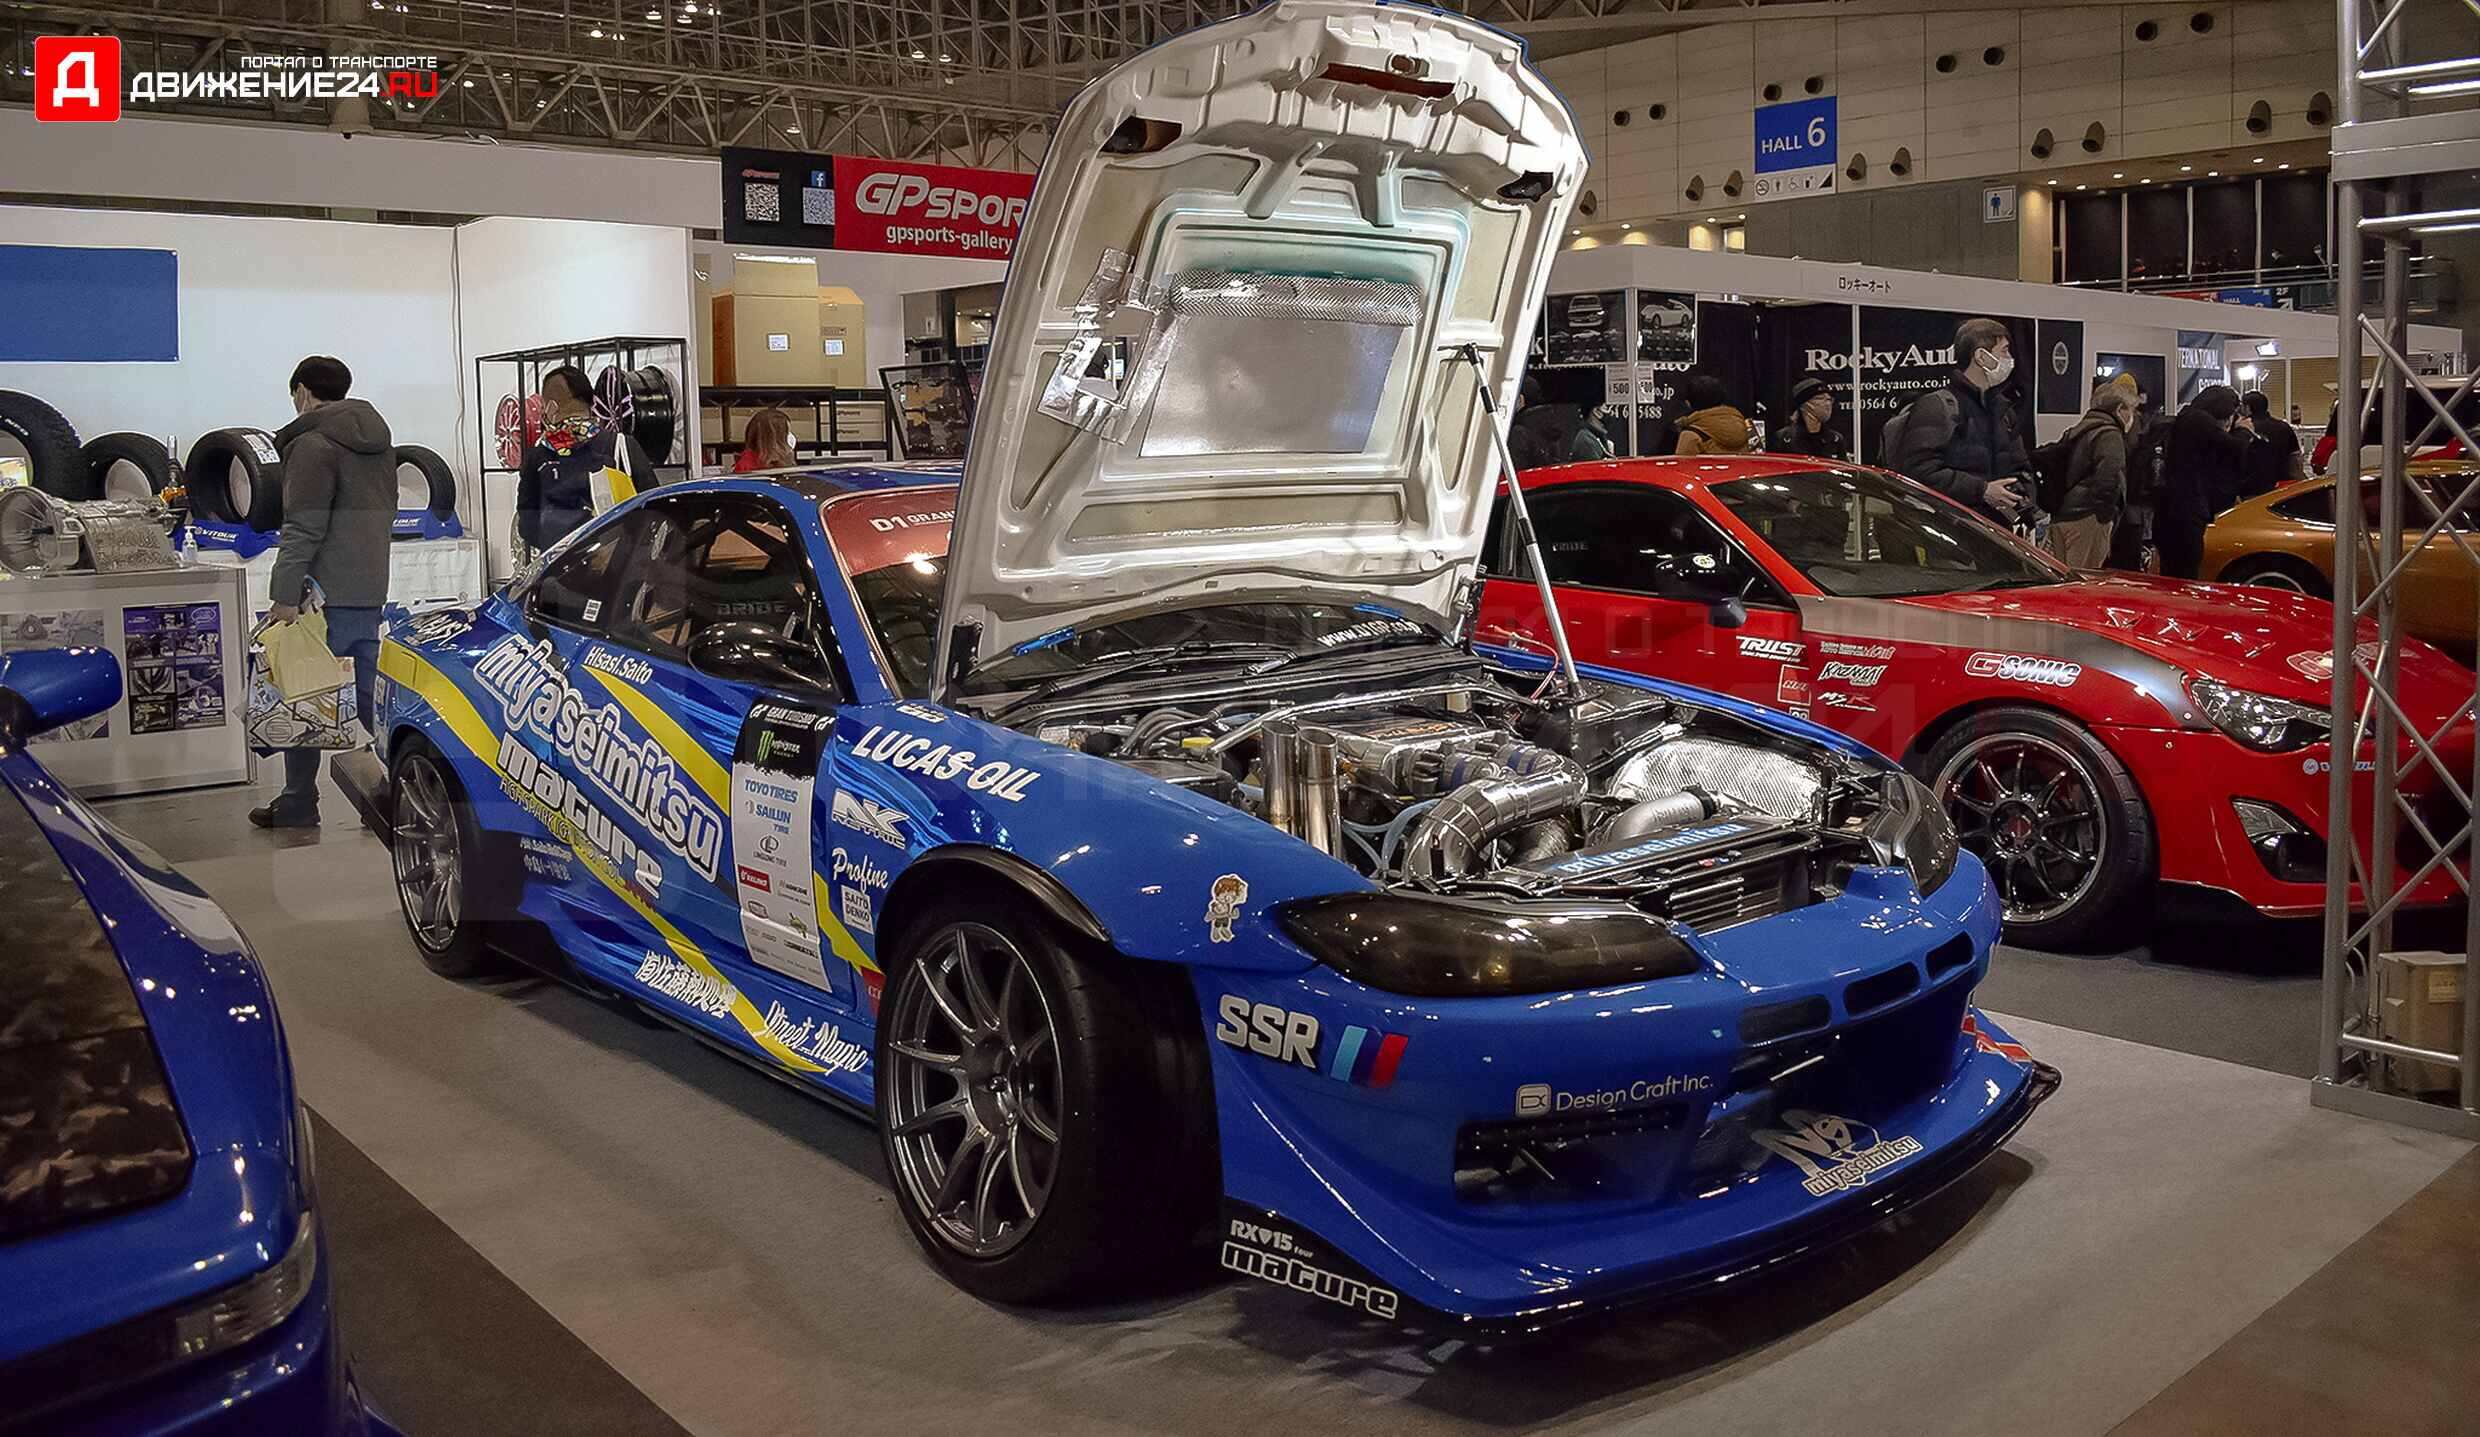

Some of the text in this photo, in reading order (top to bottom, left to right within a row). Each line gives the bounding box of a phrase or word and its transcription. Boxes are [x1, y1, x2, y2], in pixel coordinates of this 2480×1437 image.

[1761, 117, 1827, 155] HALL 6
[1838, 276, 1892, 294] ロッキーオート
[868, 515, 911, 532] D1
[717, 600, 788, 616] BRIDE
[1735, 635, 1807, 656] TRUST
[472, 634, 723, 883] miyaseimitsu
[851, 726, 1041, 802] LUCAS OIL
[496, 731, 665, 899] mature
[755, 803, 792, 824] SAILUN
[1558, 821, 1750, 874] miyaseimitsu
[831, 847, 889, 895] Profine
[843, 890, 870, 909] SAITO
[845, 904, 871, 923] DENKO
[1216, 993, 1321, 1070] SSR
[1555, 1074, 1714, 1112] Design Craft Inc.
[1803, 1136, 1923, 1196] miyaseimitsu
[1221, 1241, 1399, 1320] mature
